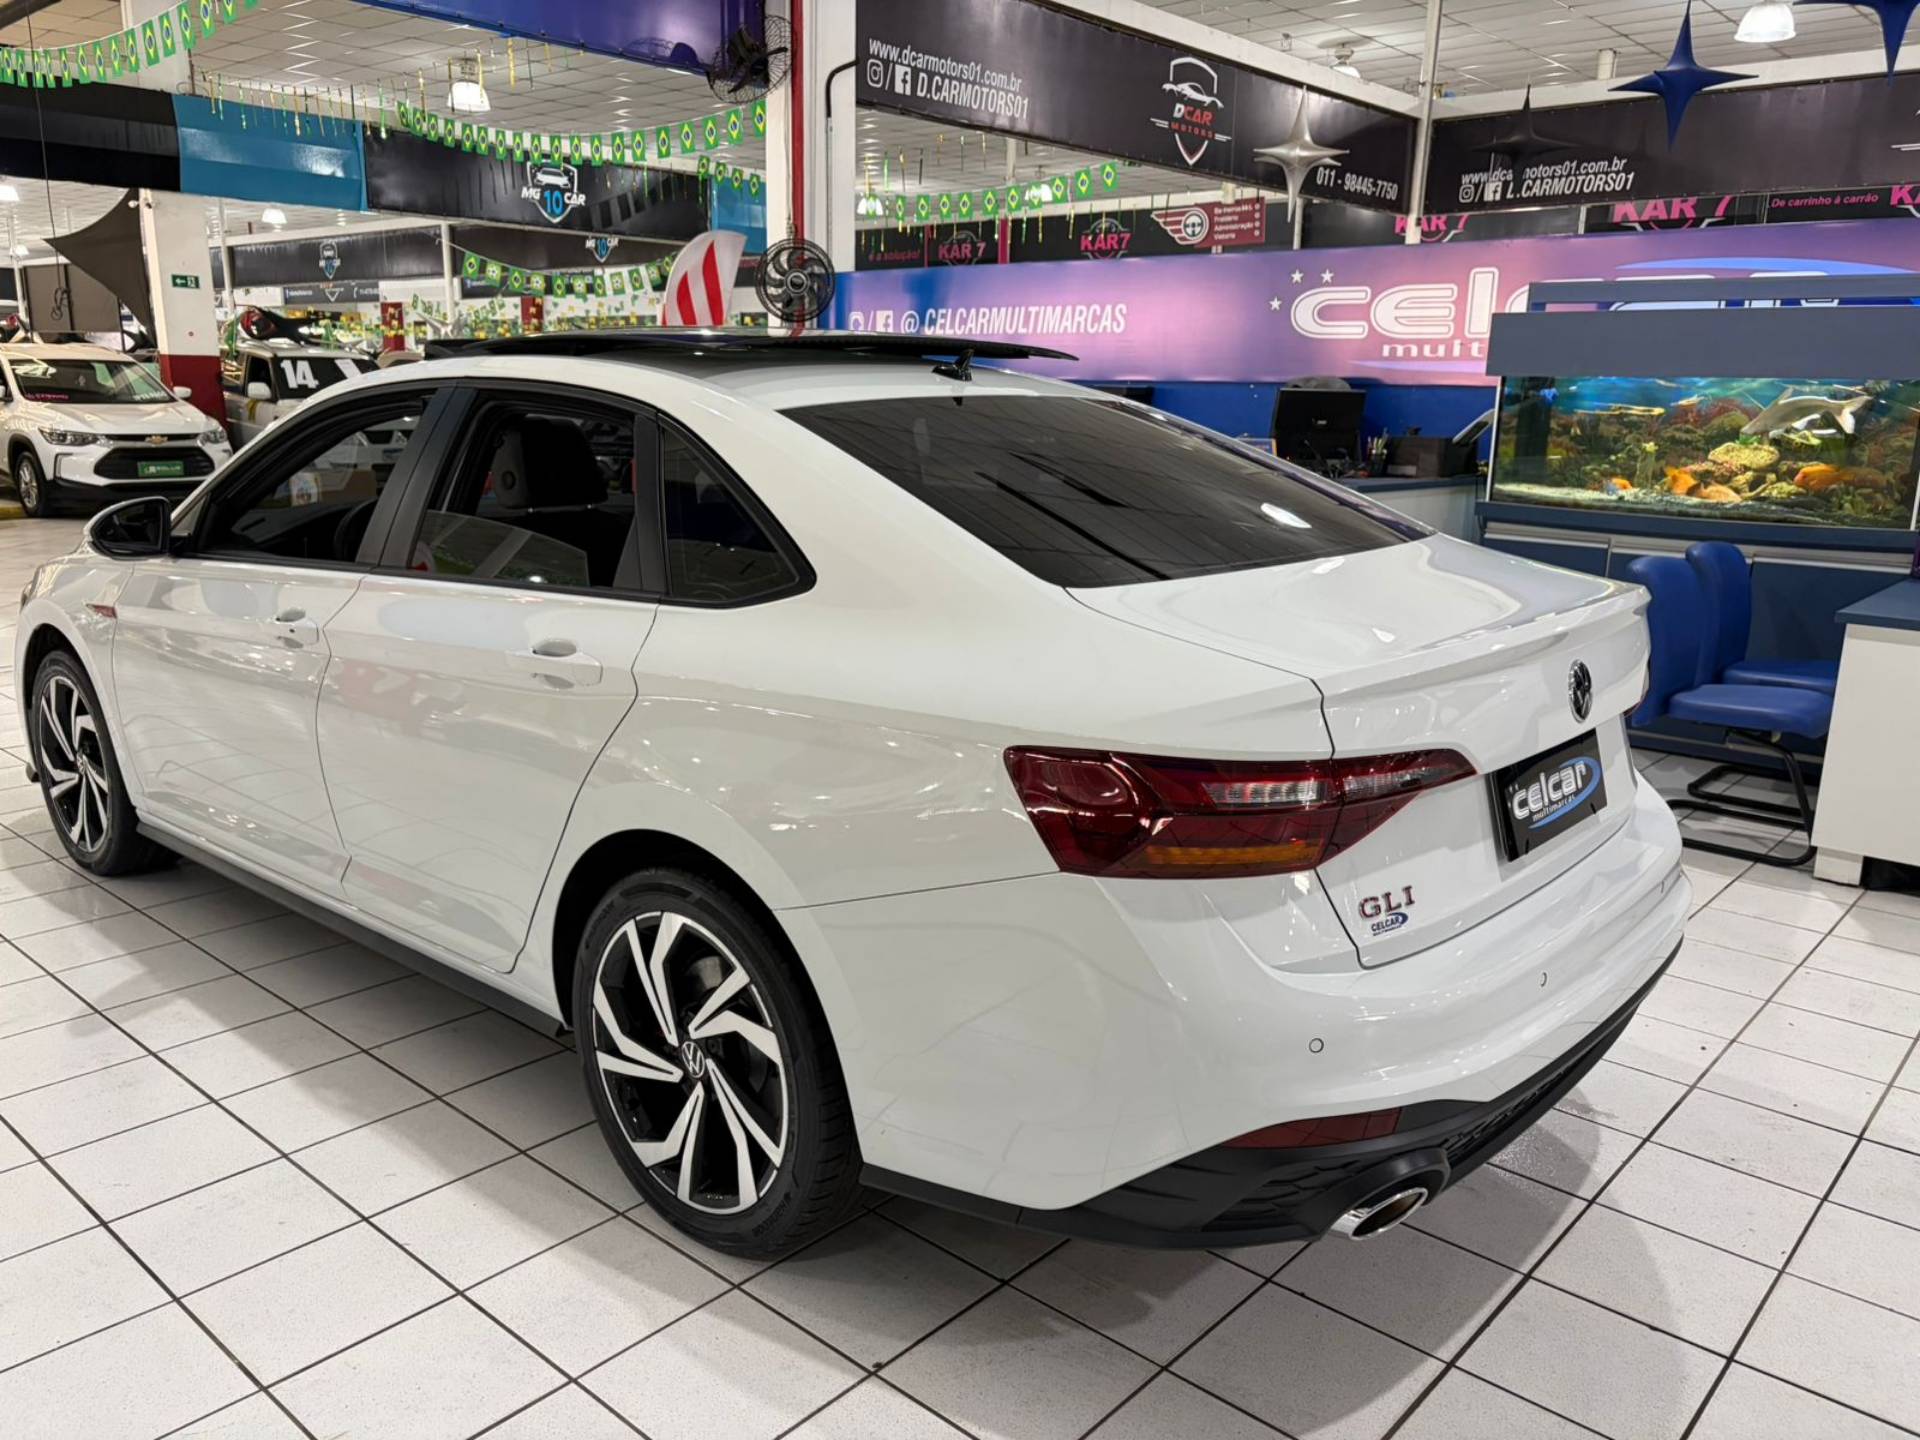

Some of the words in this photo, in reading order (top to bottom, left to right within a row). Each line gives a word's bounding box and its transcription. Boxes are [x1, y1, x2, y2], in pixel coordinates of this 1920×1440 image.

[869, 38, 1022, 92] www.dcarmotors01.com.br
[917, 72, 1029, 119] D.CARMOTORS01
[1173, 103, 1213, 126] DCAR
[1316, 166, 1336, 187] 011
[1344, 172, 1399, 200] 98445-7750
[521, 186, 541, 200] MG
[544, 190, 563, 214] 10
[563, 192, 586, 206] CAR
[1612, 197, 1697, 222] KAR
[1771, 197, 1786, 208] De
[1788, 195, 1832, 208] carrinho
[938, 243, 972, 260] KAR
[925, 304, 1128, 335] CELCARMULTIMARCAS
[1513, 760, 1588, 820] celcar
[1359, 885, 1415, 918] GLI
